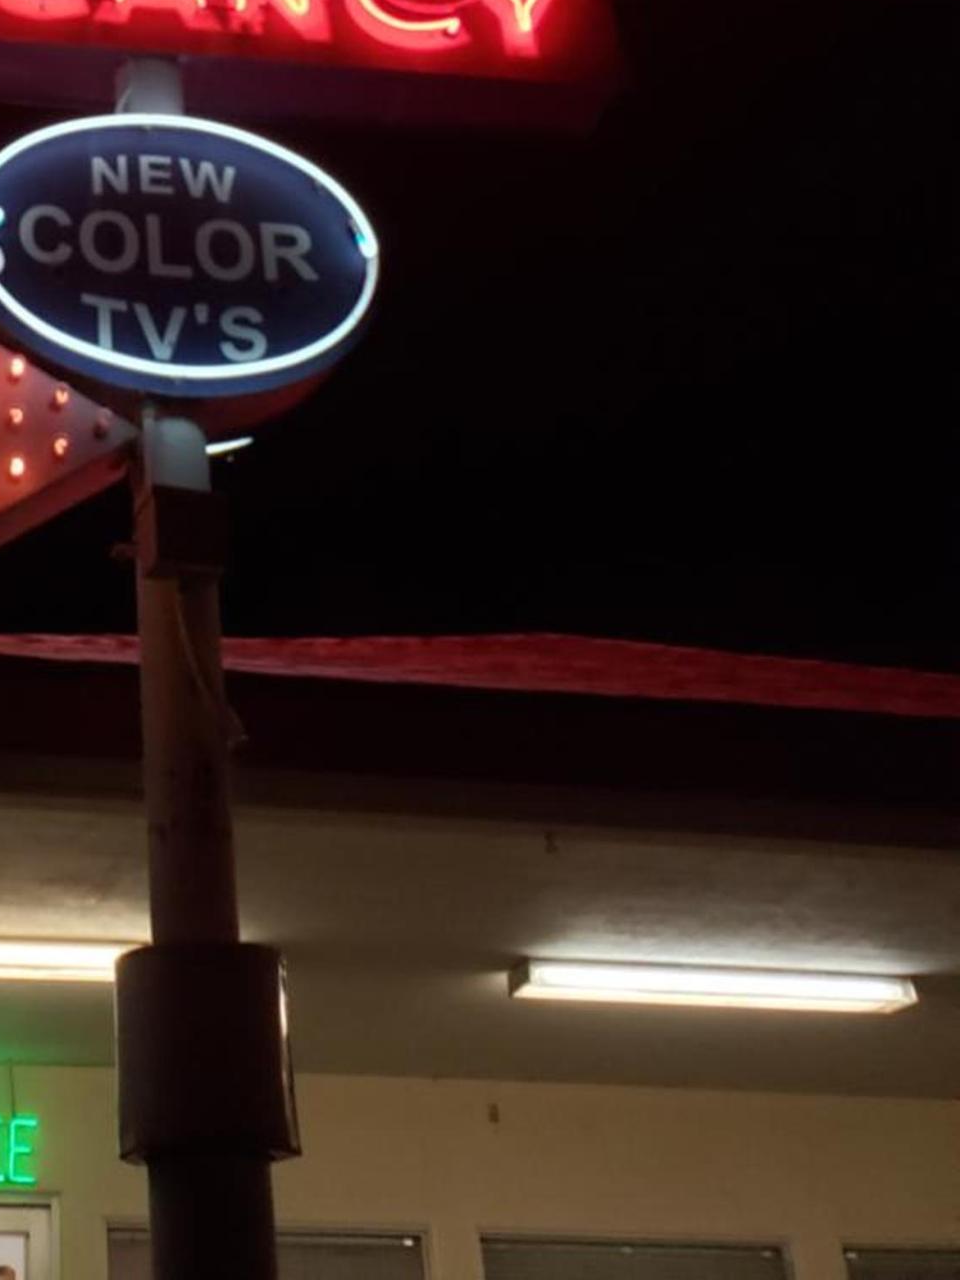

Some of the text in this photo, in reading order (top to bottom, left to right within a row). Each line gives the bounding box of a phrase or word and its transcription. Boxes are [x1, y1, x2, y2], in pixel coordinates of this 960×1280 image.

[90, 154, 236, 202] NEW
[18, 204, 318, 282] COLOR
[81, 293, 268, 362] TV'S
